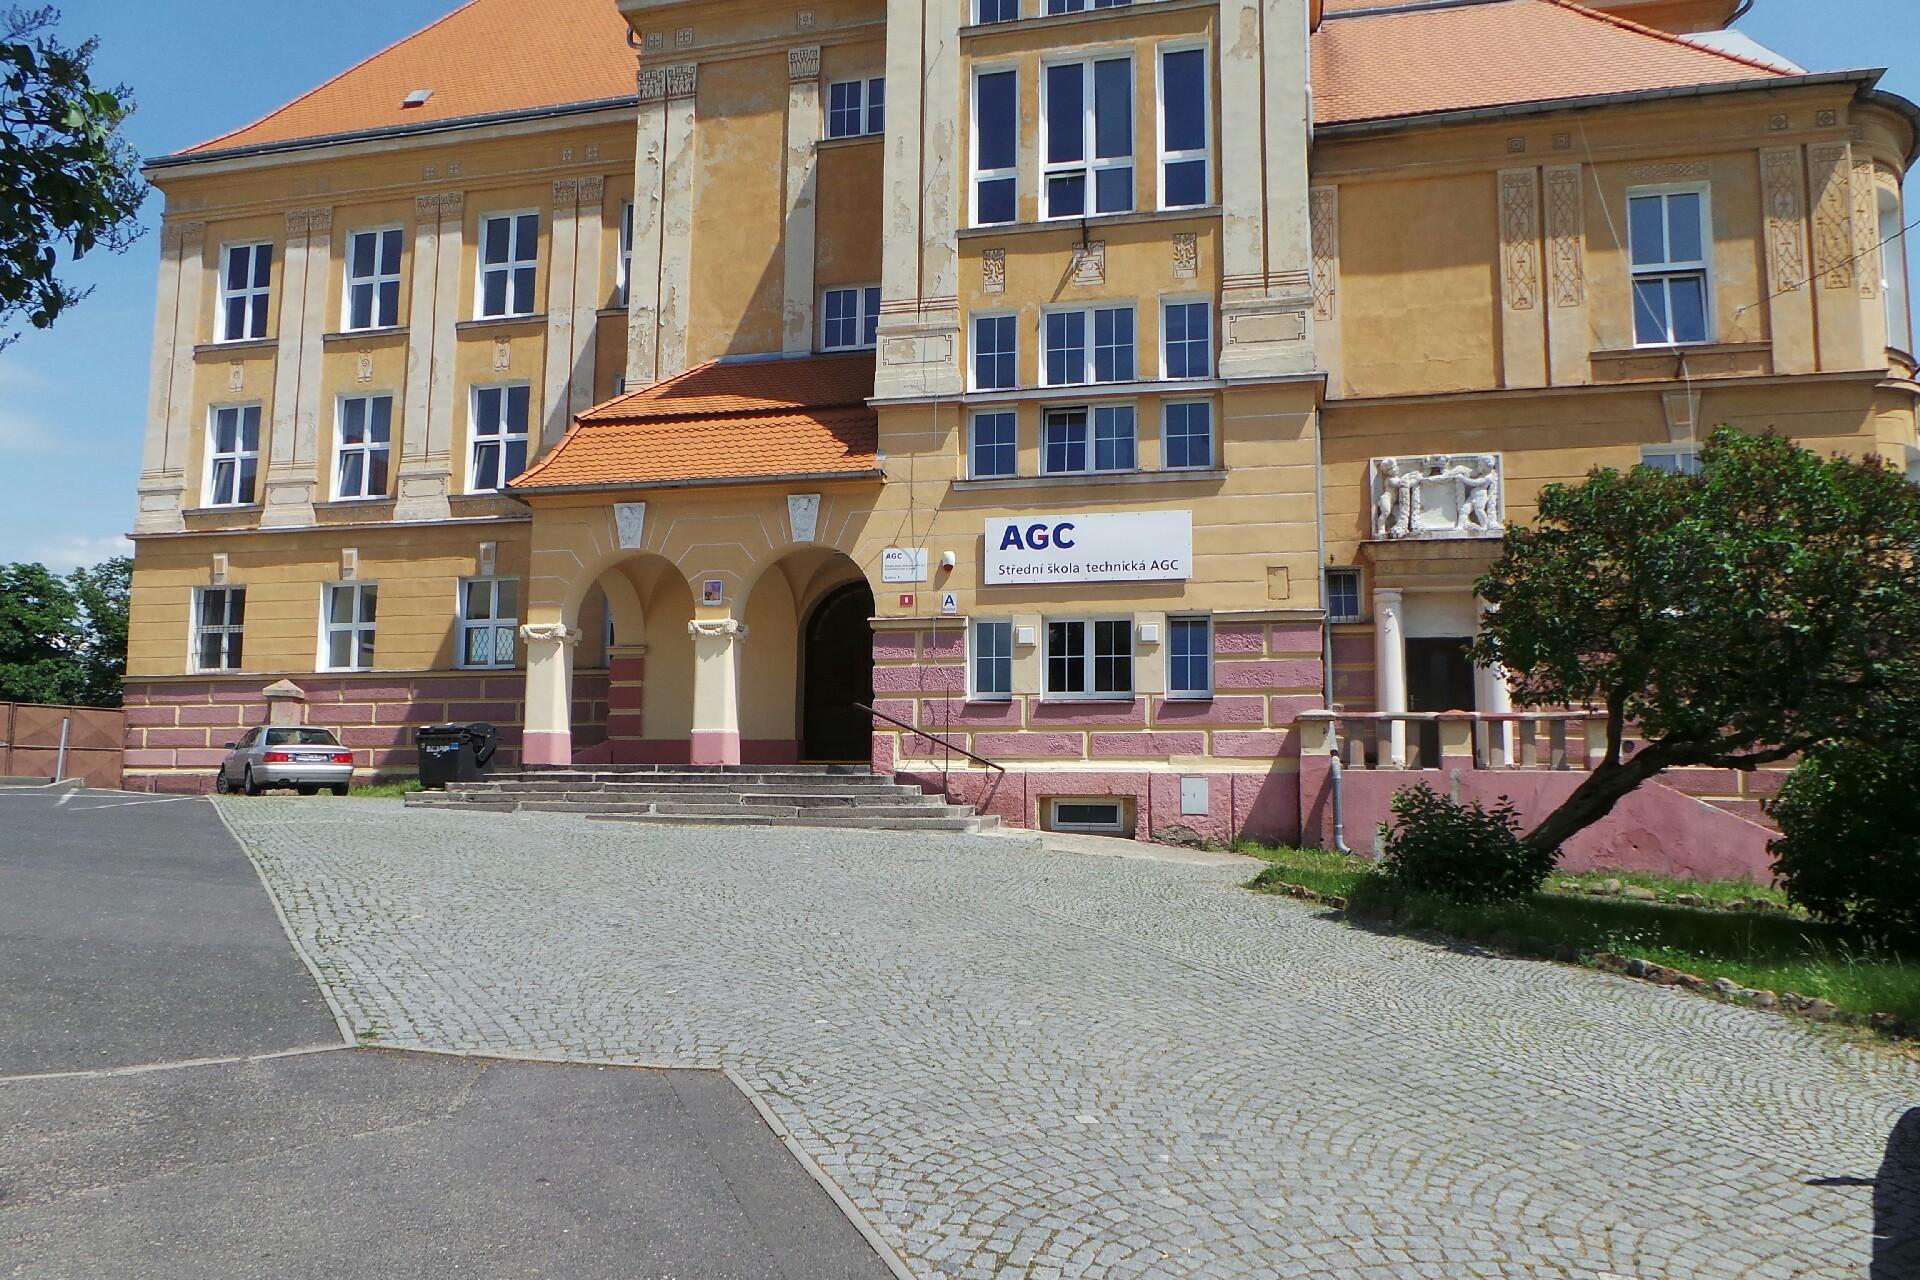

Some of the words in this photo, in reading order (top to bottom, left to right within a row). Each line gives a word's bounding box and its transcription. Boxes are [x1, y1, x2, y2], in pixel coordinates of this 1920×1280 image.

[1000, 523, 1075, 550] AGC
[885, 552, 903, 560] AGC
[998, 563, 1043, 575] Střední
[1047, 562, 1080, 574] škola
[1086, 560, 1146, 572] technická
[1150, 559, 1179, 571] AGC
[944, 594, 954, 606] A
